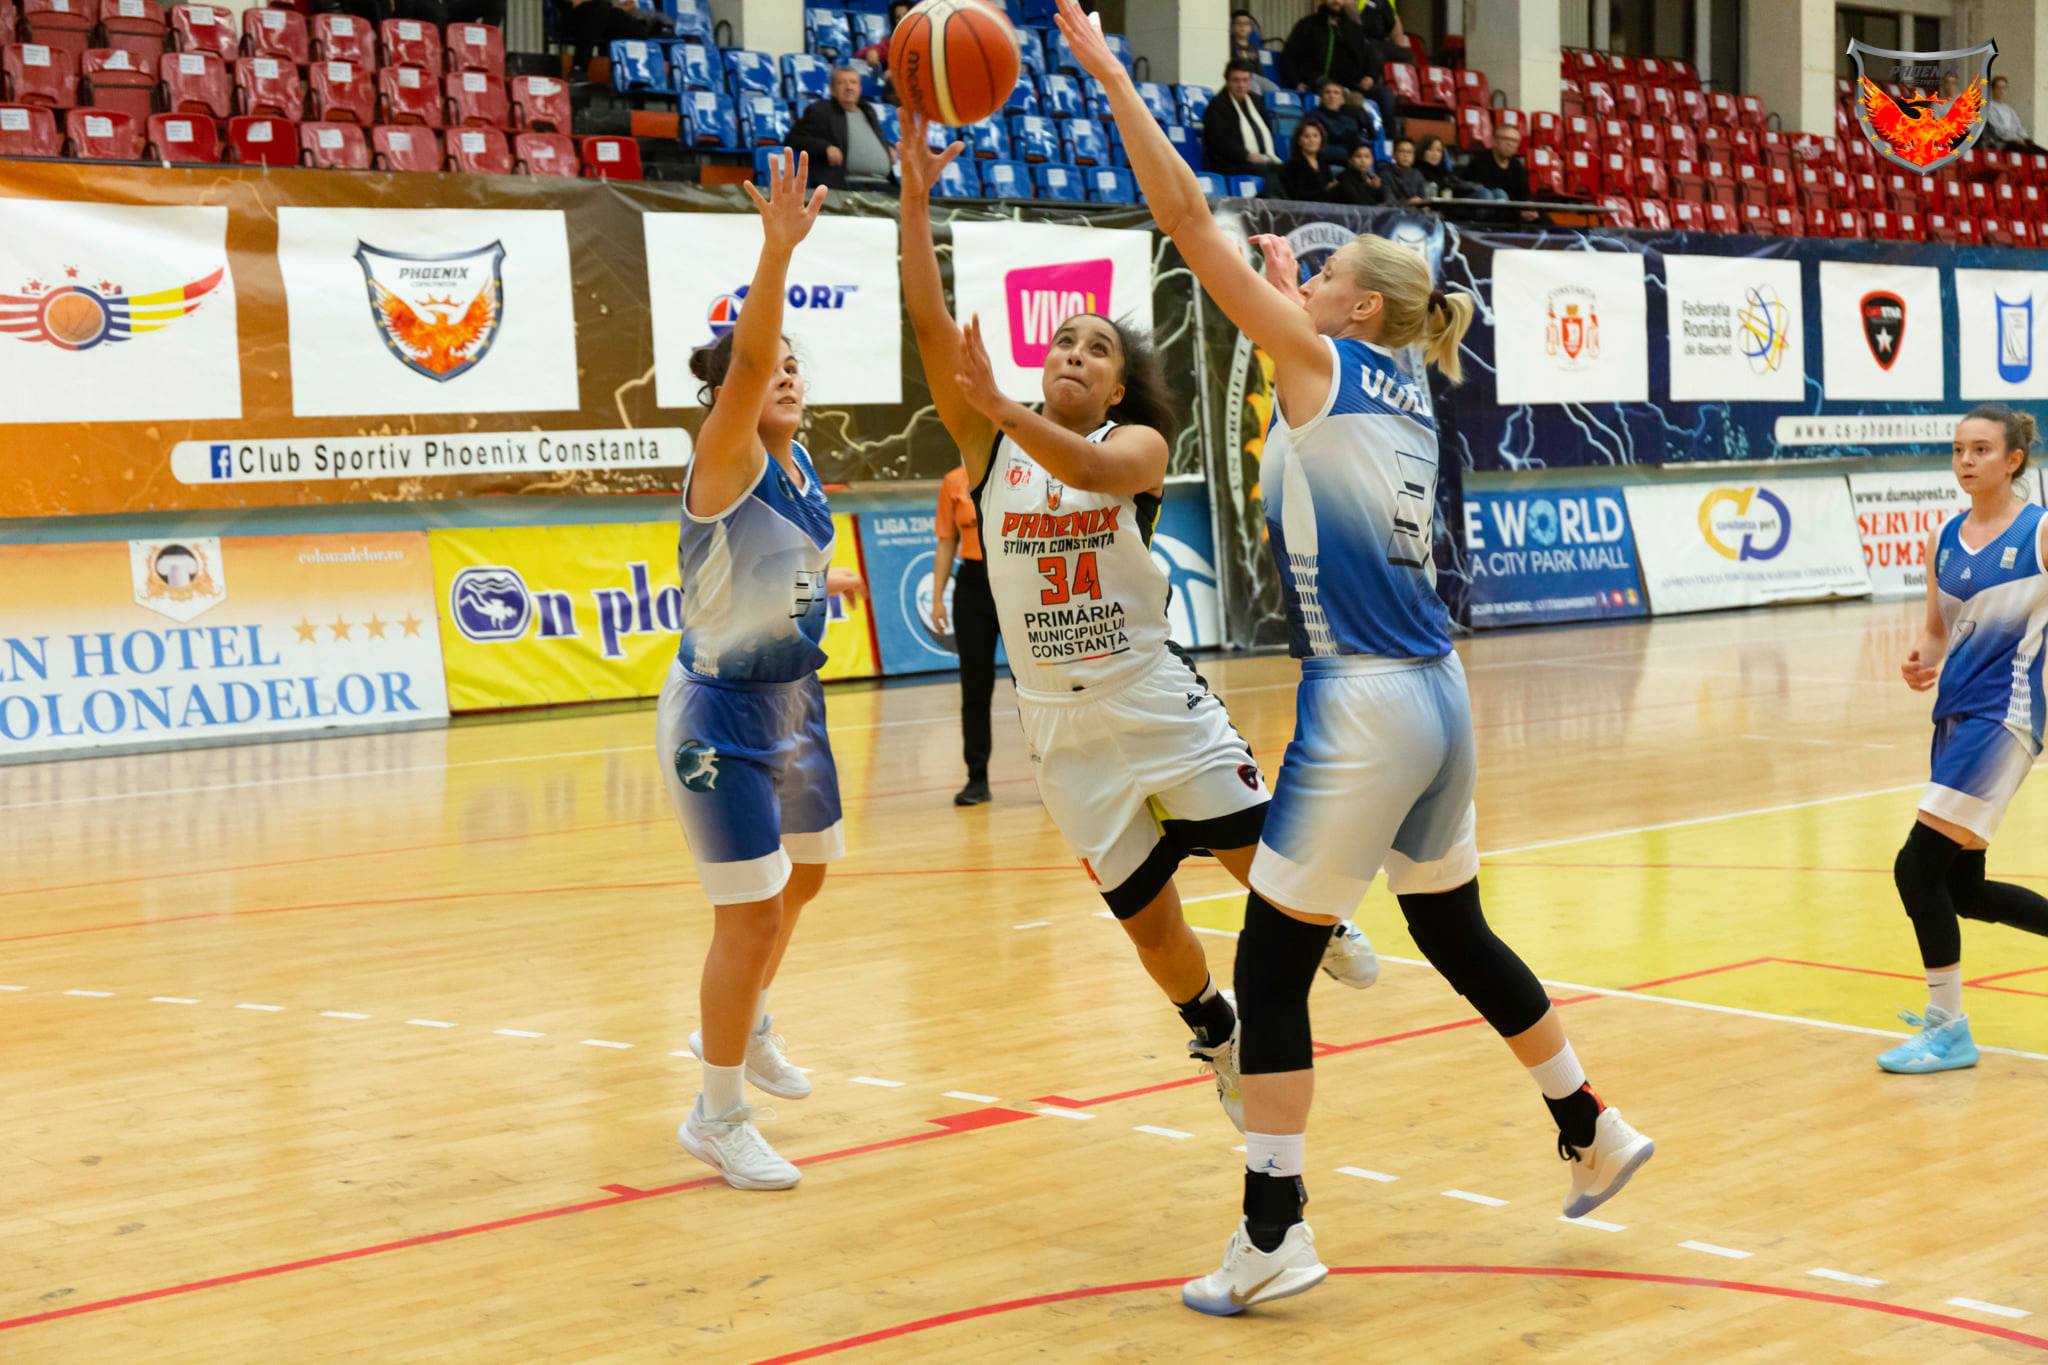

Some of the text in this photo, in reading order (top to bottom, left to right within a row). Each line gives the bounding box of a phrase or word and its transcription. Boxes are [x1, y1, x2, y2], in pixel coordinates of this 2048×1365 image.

[399, 266, 470, 281] PHOENIX
[239, 436, 661, 478] Club Sportiv Phoenix Constanta
[1001, 505, 1122, 539] PHOENIX
[1491, 497, 1625, 547] WORLD
[1489, 551, 1528, 578] CITY
[1530, 546, 1579, 577] PARK
[1580, 544, 1631, 572] MALL
[1037, 551, 1103, 606] 34
[1023, 601, 1125, 629] PRIMĂRIA
[1028, 617, 1126, 644] MUNICIPIULUI
[67, 624, 281, 679] HOTEL
[1031, 631, 1129, 659] CONSTANȚA
